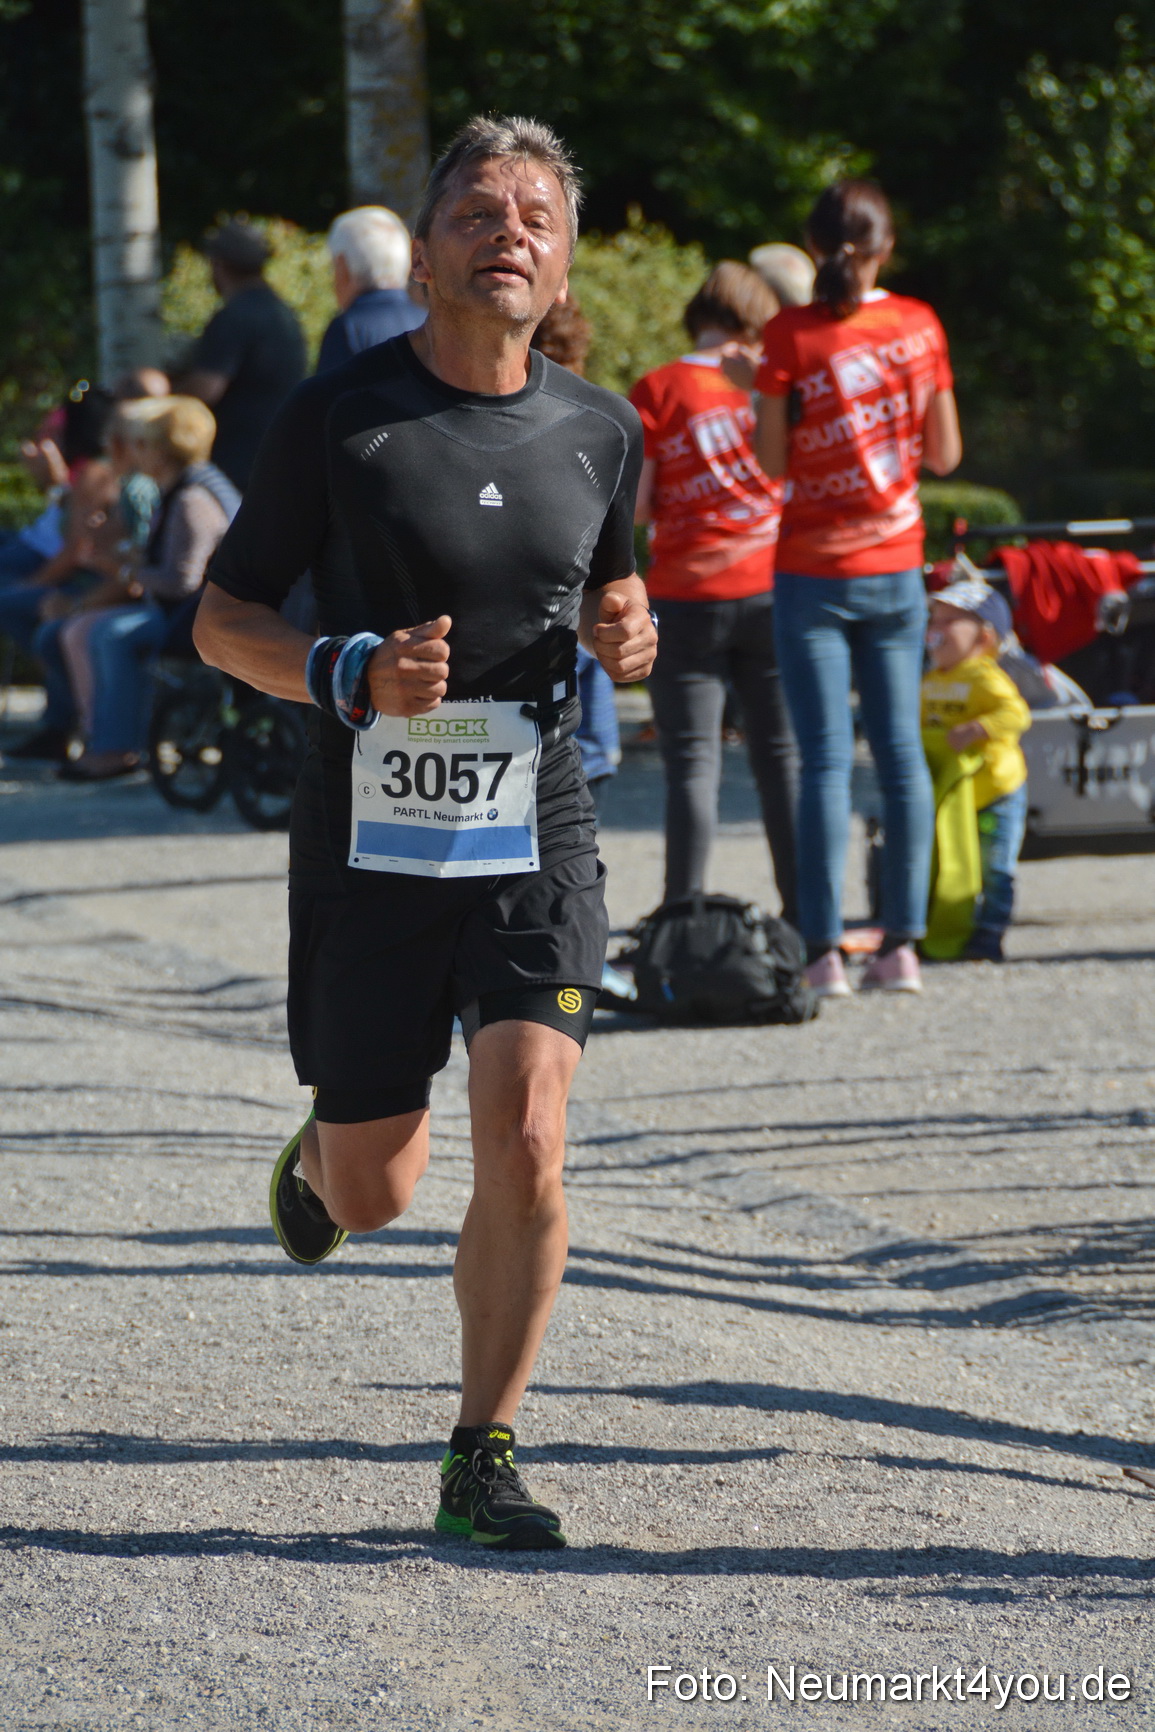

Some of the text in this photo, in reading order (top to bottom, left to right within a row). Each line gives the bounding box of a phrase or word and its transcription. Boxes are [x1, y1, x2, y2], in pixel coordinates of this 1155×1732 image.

[408, 718, 489, 737] BOCK
[381, 750, 513, 804] 3057
[393, 807, 484, 823] PARTL Neumarkt
